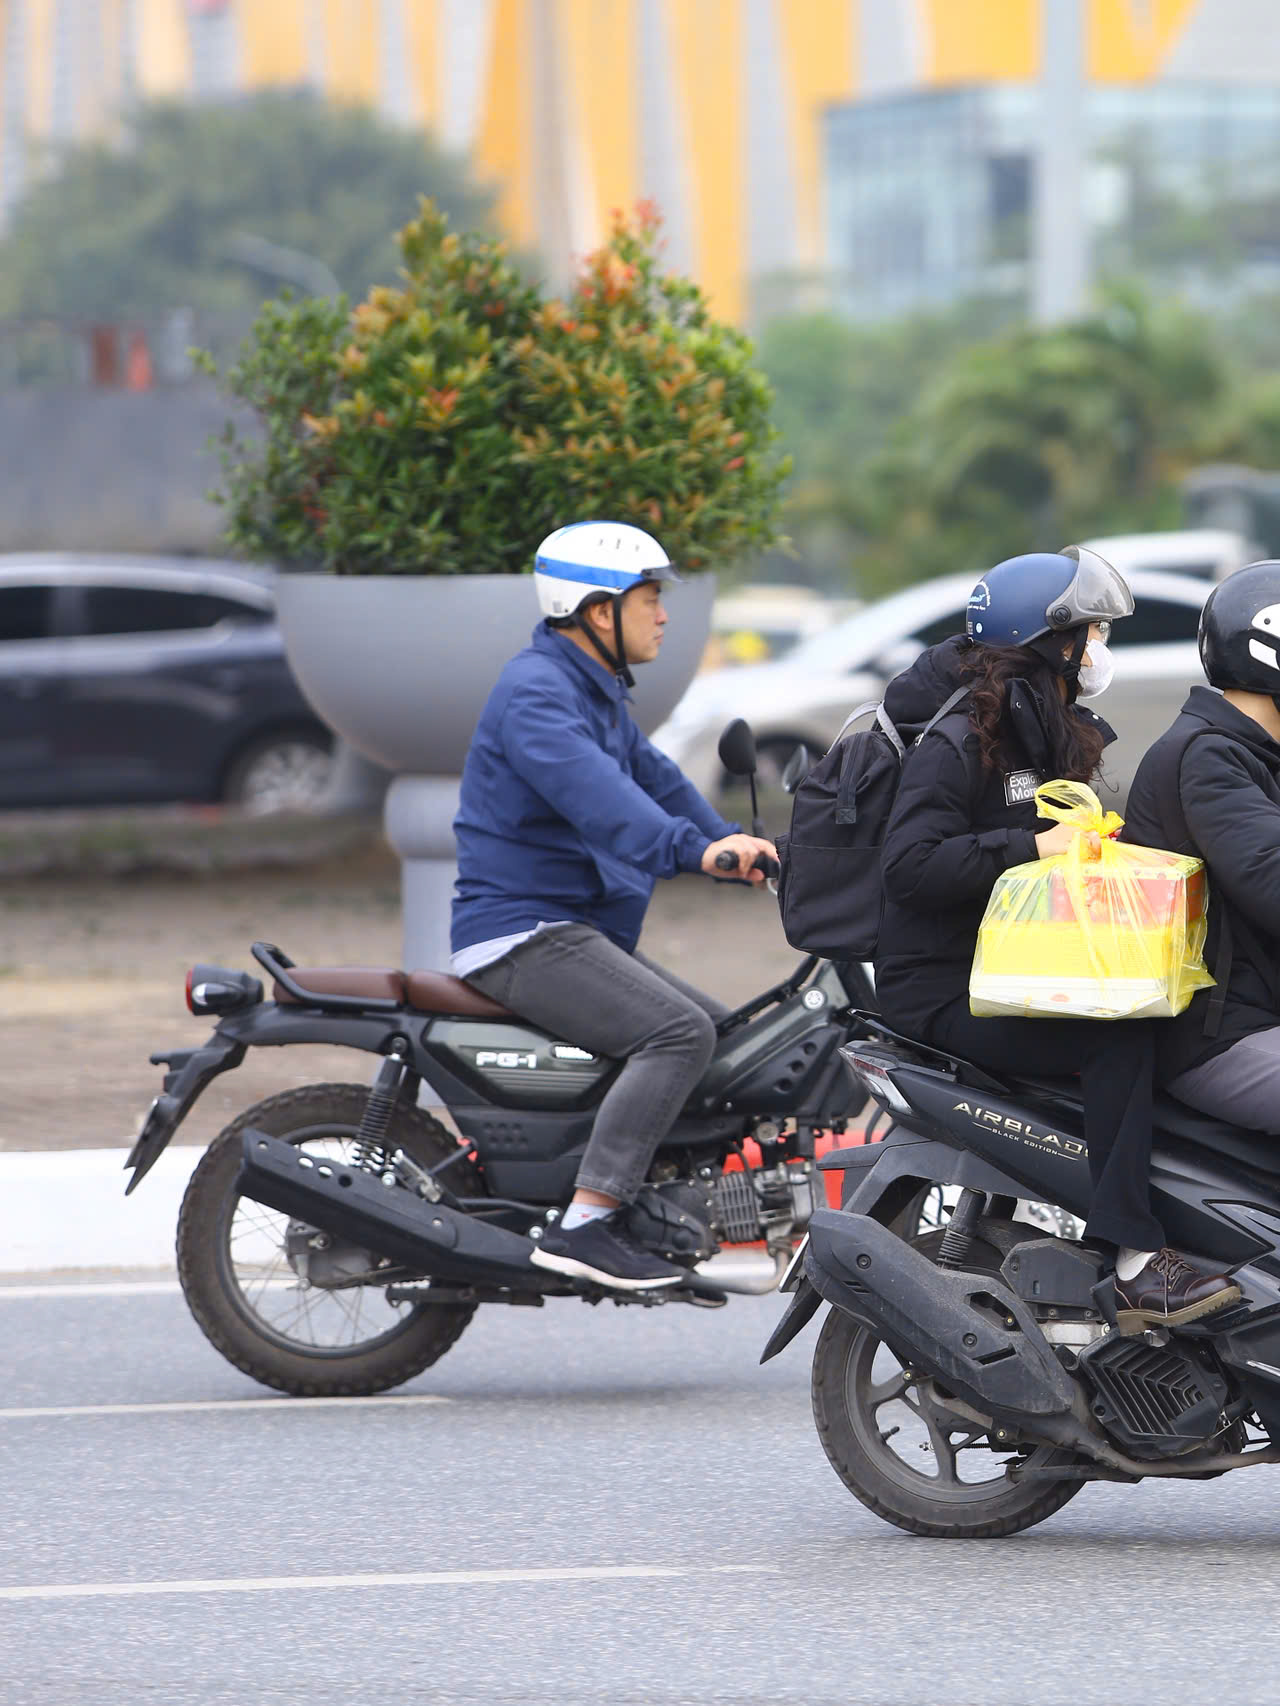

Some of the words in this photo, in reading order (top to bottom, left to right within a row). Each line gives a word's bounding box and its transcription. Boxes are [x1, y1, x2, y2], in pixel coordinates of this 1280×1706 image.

[475, 1051, 537, 1069] PG-1
[953, 1102, 1089, 1157] AIRBLAD
[992, 1128, 1020, 1142] BLACK
[1023, 1140, 1058, 1156] EDITION
